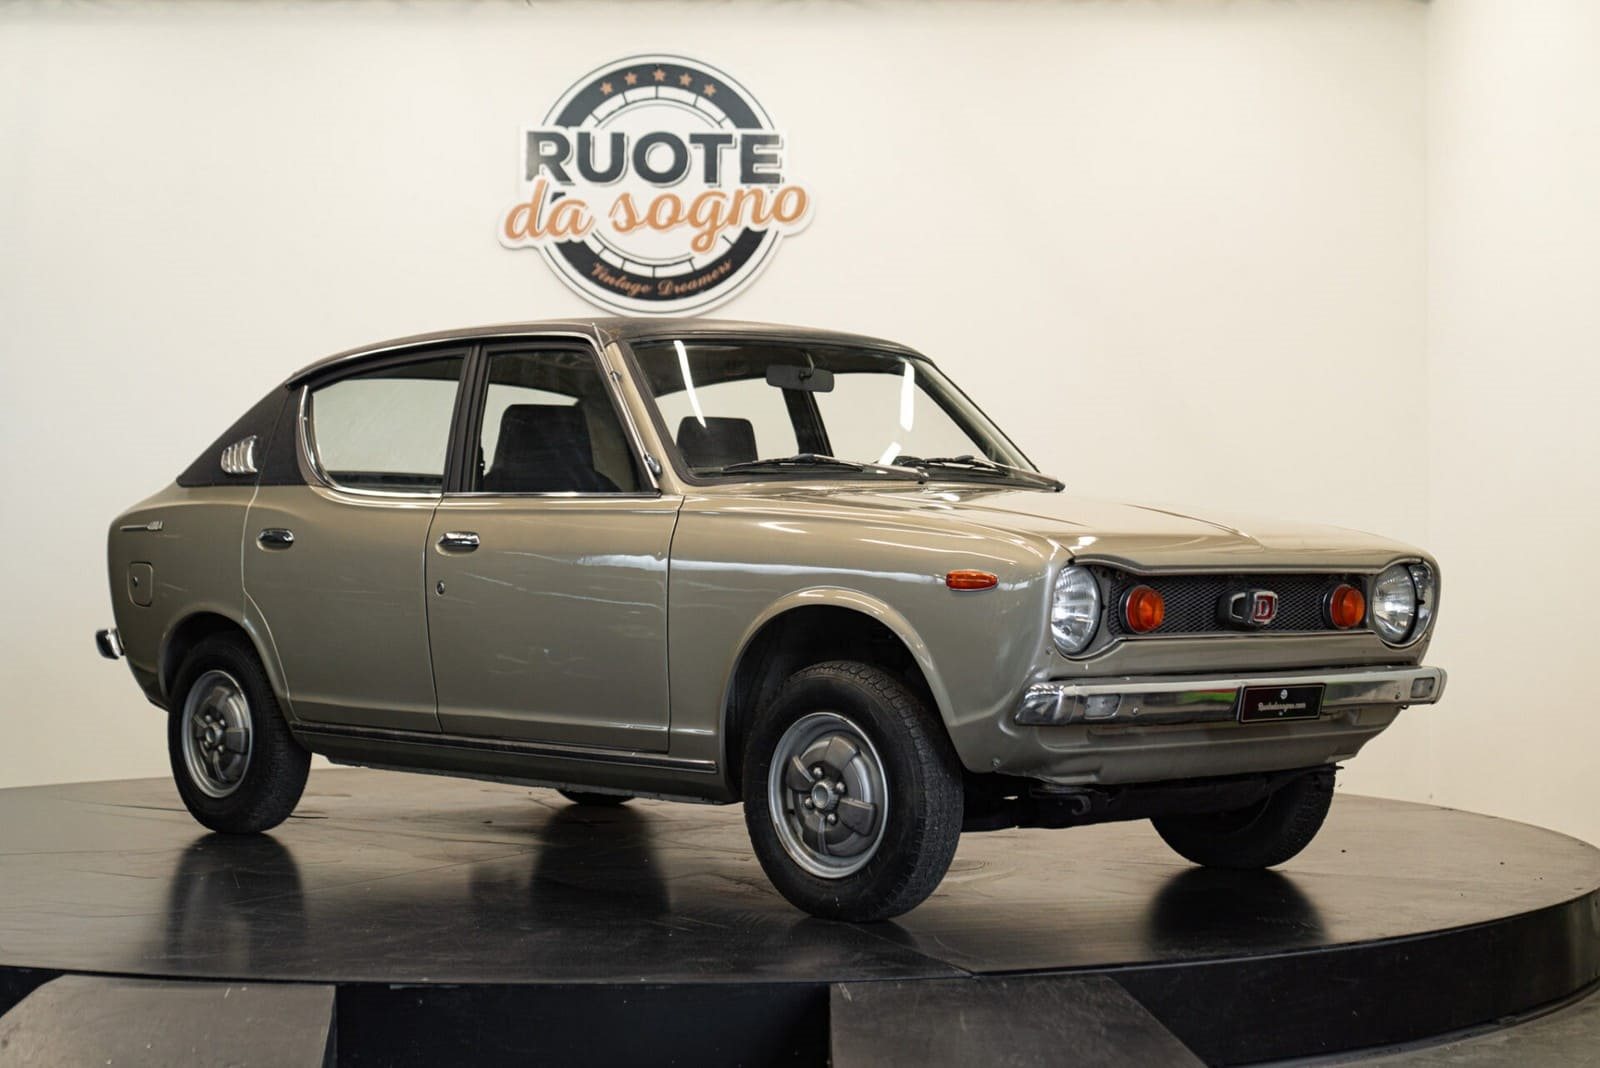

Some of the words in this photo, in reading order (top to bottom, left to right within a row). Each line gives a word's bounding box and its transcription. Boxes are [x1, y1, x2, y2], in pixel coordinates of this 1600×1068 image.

[526, 131, 782, 185] RUOTE
[505, 179, 591, 240] da
[609, 186, 807, 252] sogno
[591, 261, 651, 297] Vintage
[657, 259, 732, 297] Dreamers
